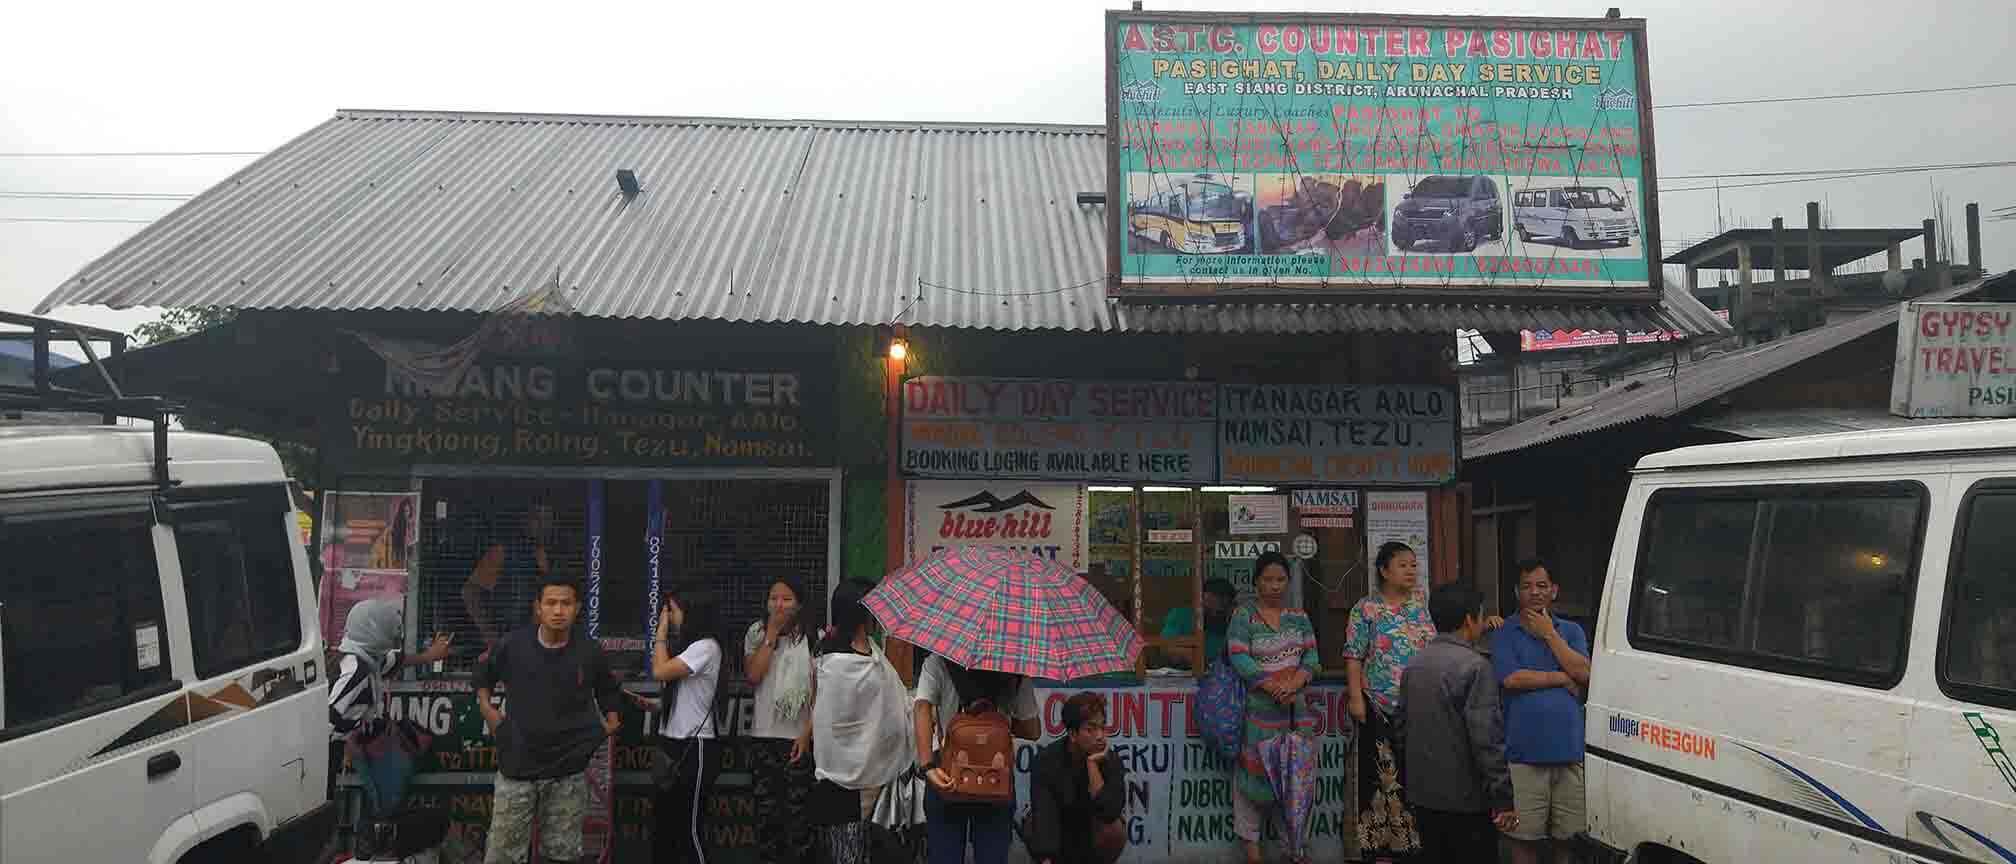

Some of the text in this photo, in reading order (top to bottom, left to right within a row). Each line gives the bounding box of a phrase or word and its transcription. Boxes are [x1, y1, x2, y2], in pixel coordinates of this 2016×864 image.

[1256, 25, 1431, 57] COUNTER
[1445, 28, 1625, 60] PASIGHAT
[1152, 59, 1601, 84] PASIGHAT, DAILY DAY SERVICE
[1184, 82, 1574, 100] EAST SIANG DISTRICT, ARUNACHAL PRADESH
[1176, 256, 1193, 264] For
[1921, 311, 2011, 338] GYPSY
[587, 368, 801, 408] COUNTER
[907, 383, 1214, 417] DAILY DAY SERVICE
[1224, 386, 1444, 416] ITANAGAR AALO
[1968, 387, 2016, 406] PASI
[905, 448, 979, 472] BOOKING
[1046, 448, 1129, 472] AVAILABLE
[1138, 449, 1192, 472] HERE
